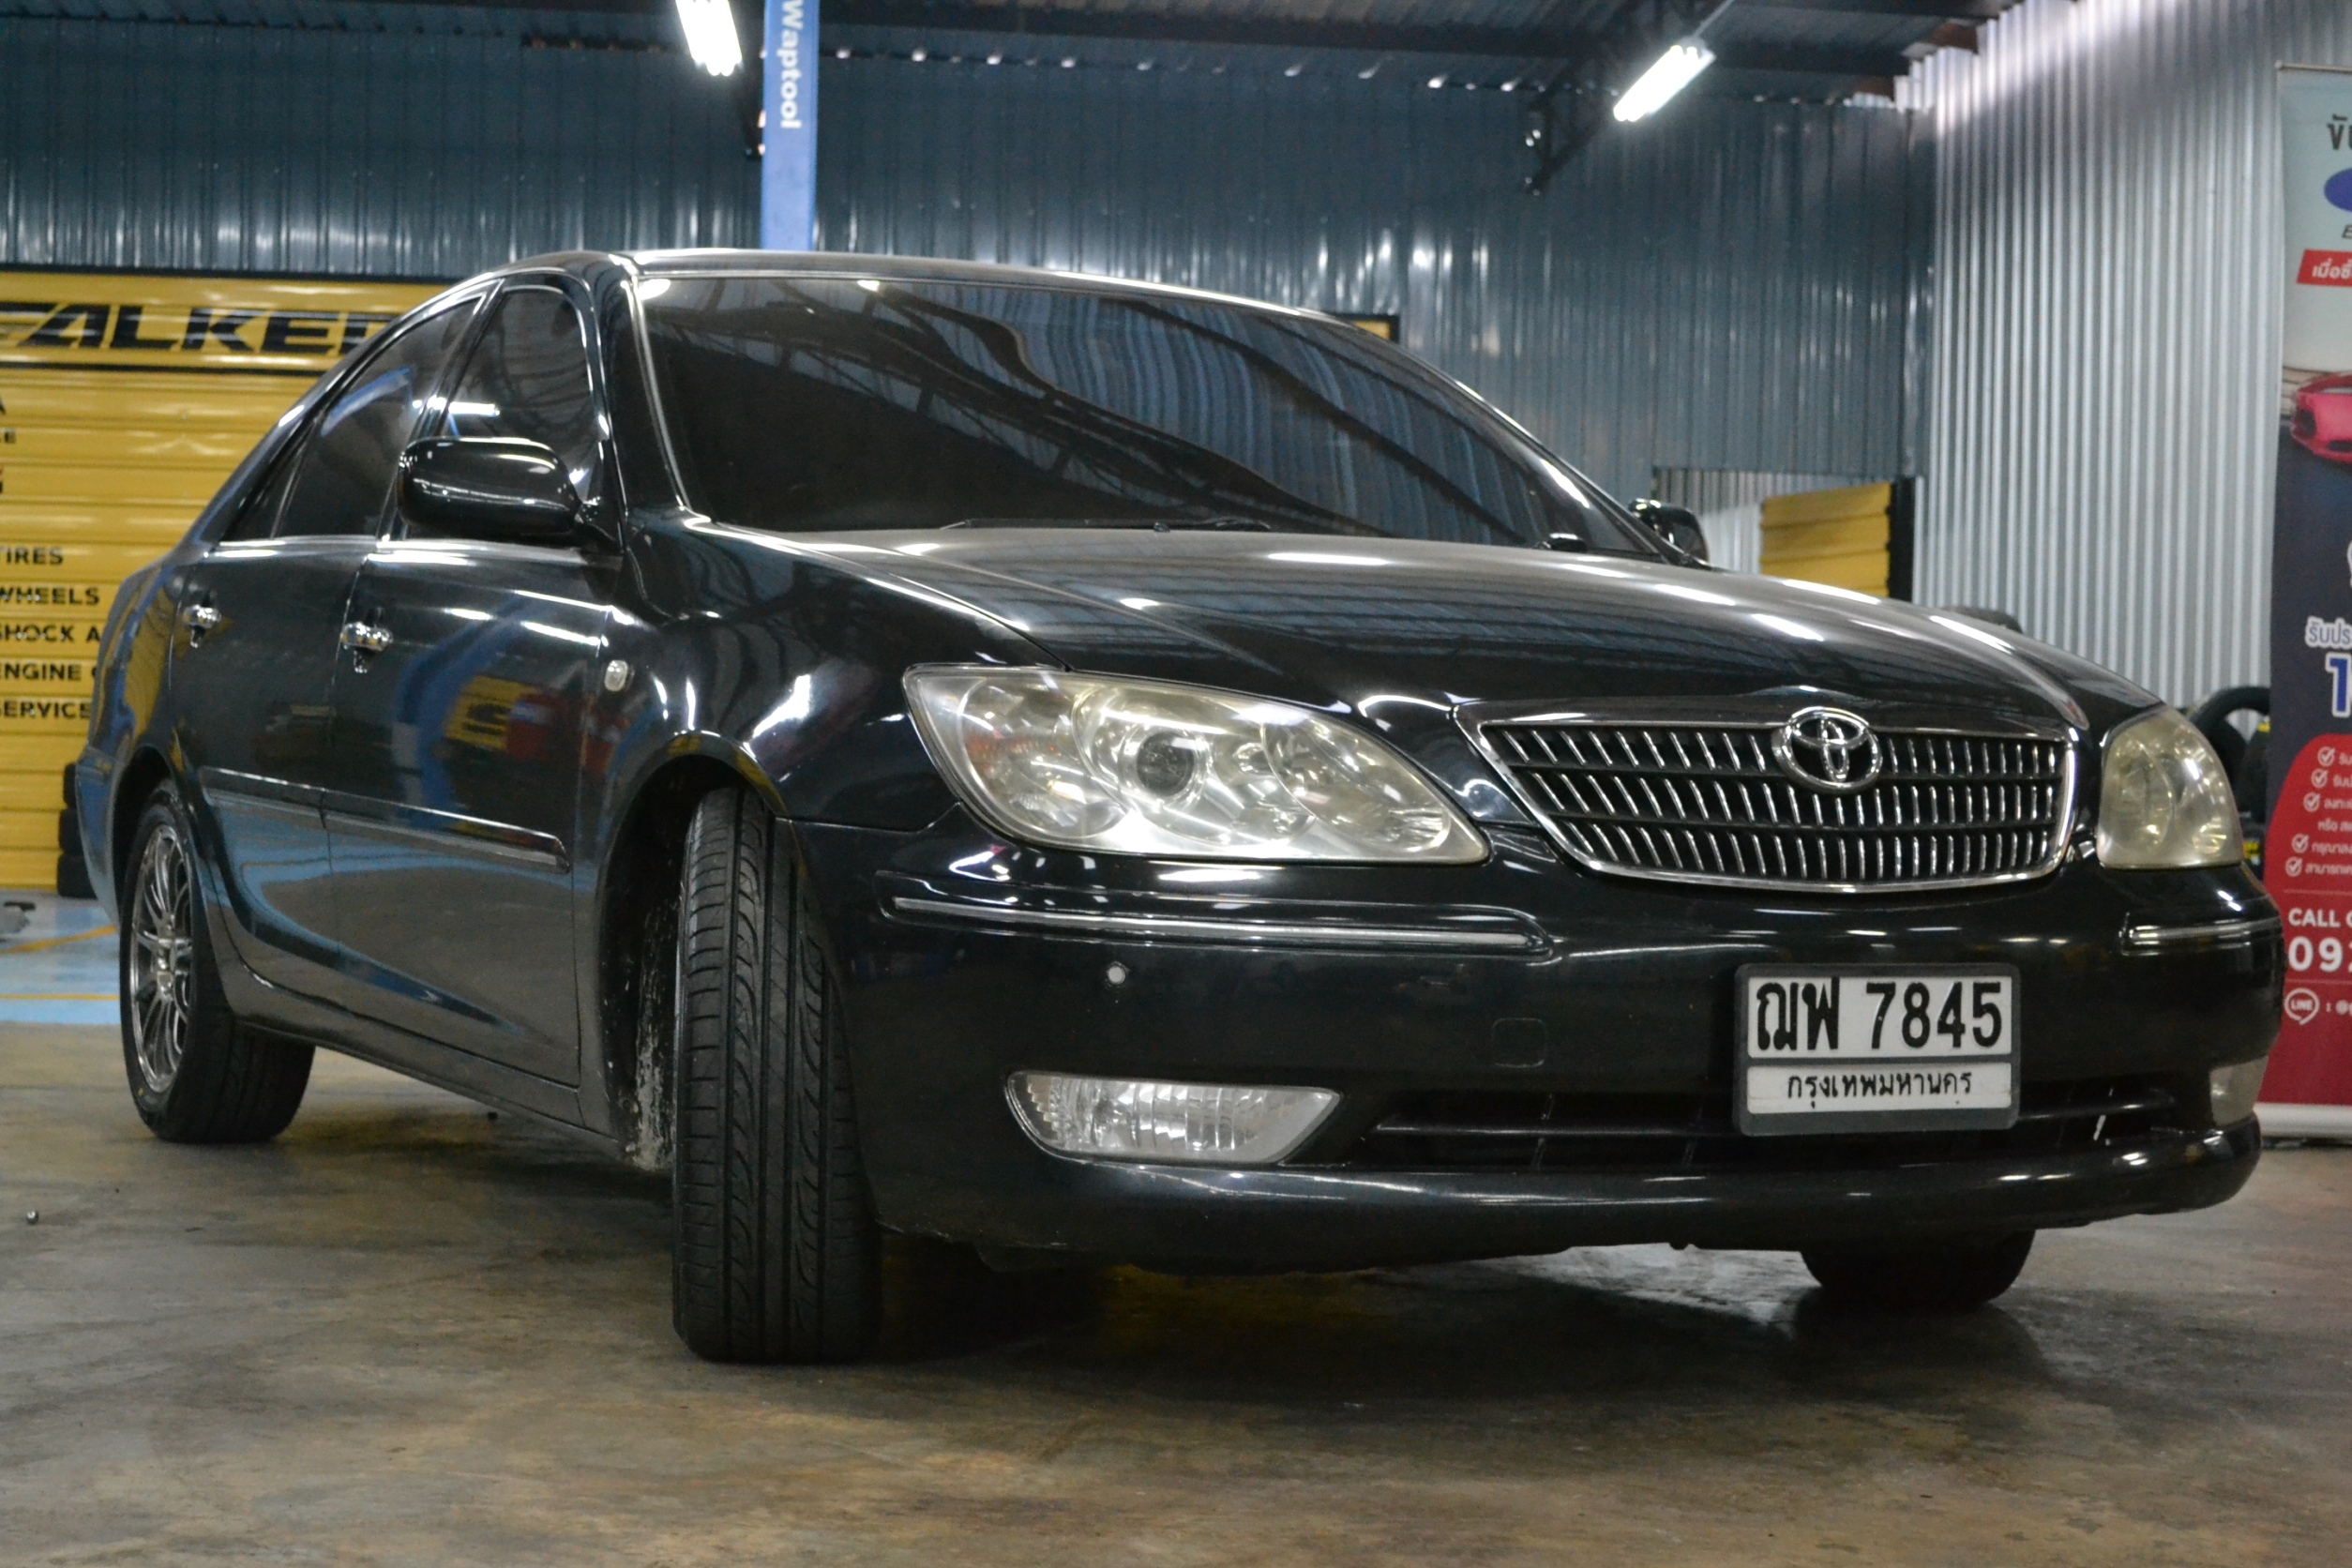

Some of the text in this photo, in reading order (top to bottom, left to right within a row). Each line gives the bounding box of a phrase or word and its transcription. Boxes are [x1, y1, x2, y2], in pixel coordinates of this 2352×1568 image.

[0, 547, 64, 565] IRES
[0, 623, 75, 642] HOCK
[0, 662, 82, 683] NGINE
[0, 701, 91, 719] ERVICE
[2288, 907, 2342, 928] CALL
[1756, 976, 2002, 1051] ฌฟ 7845
[1787, 1071, 1972, 1108] กรุงเทพมหานคร
